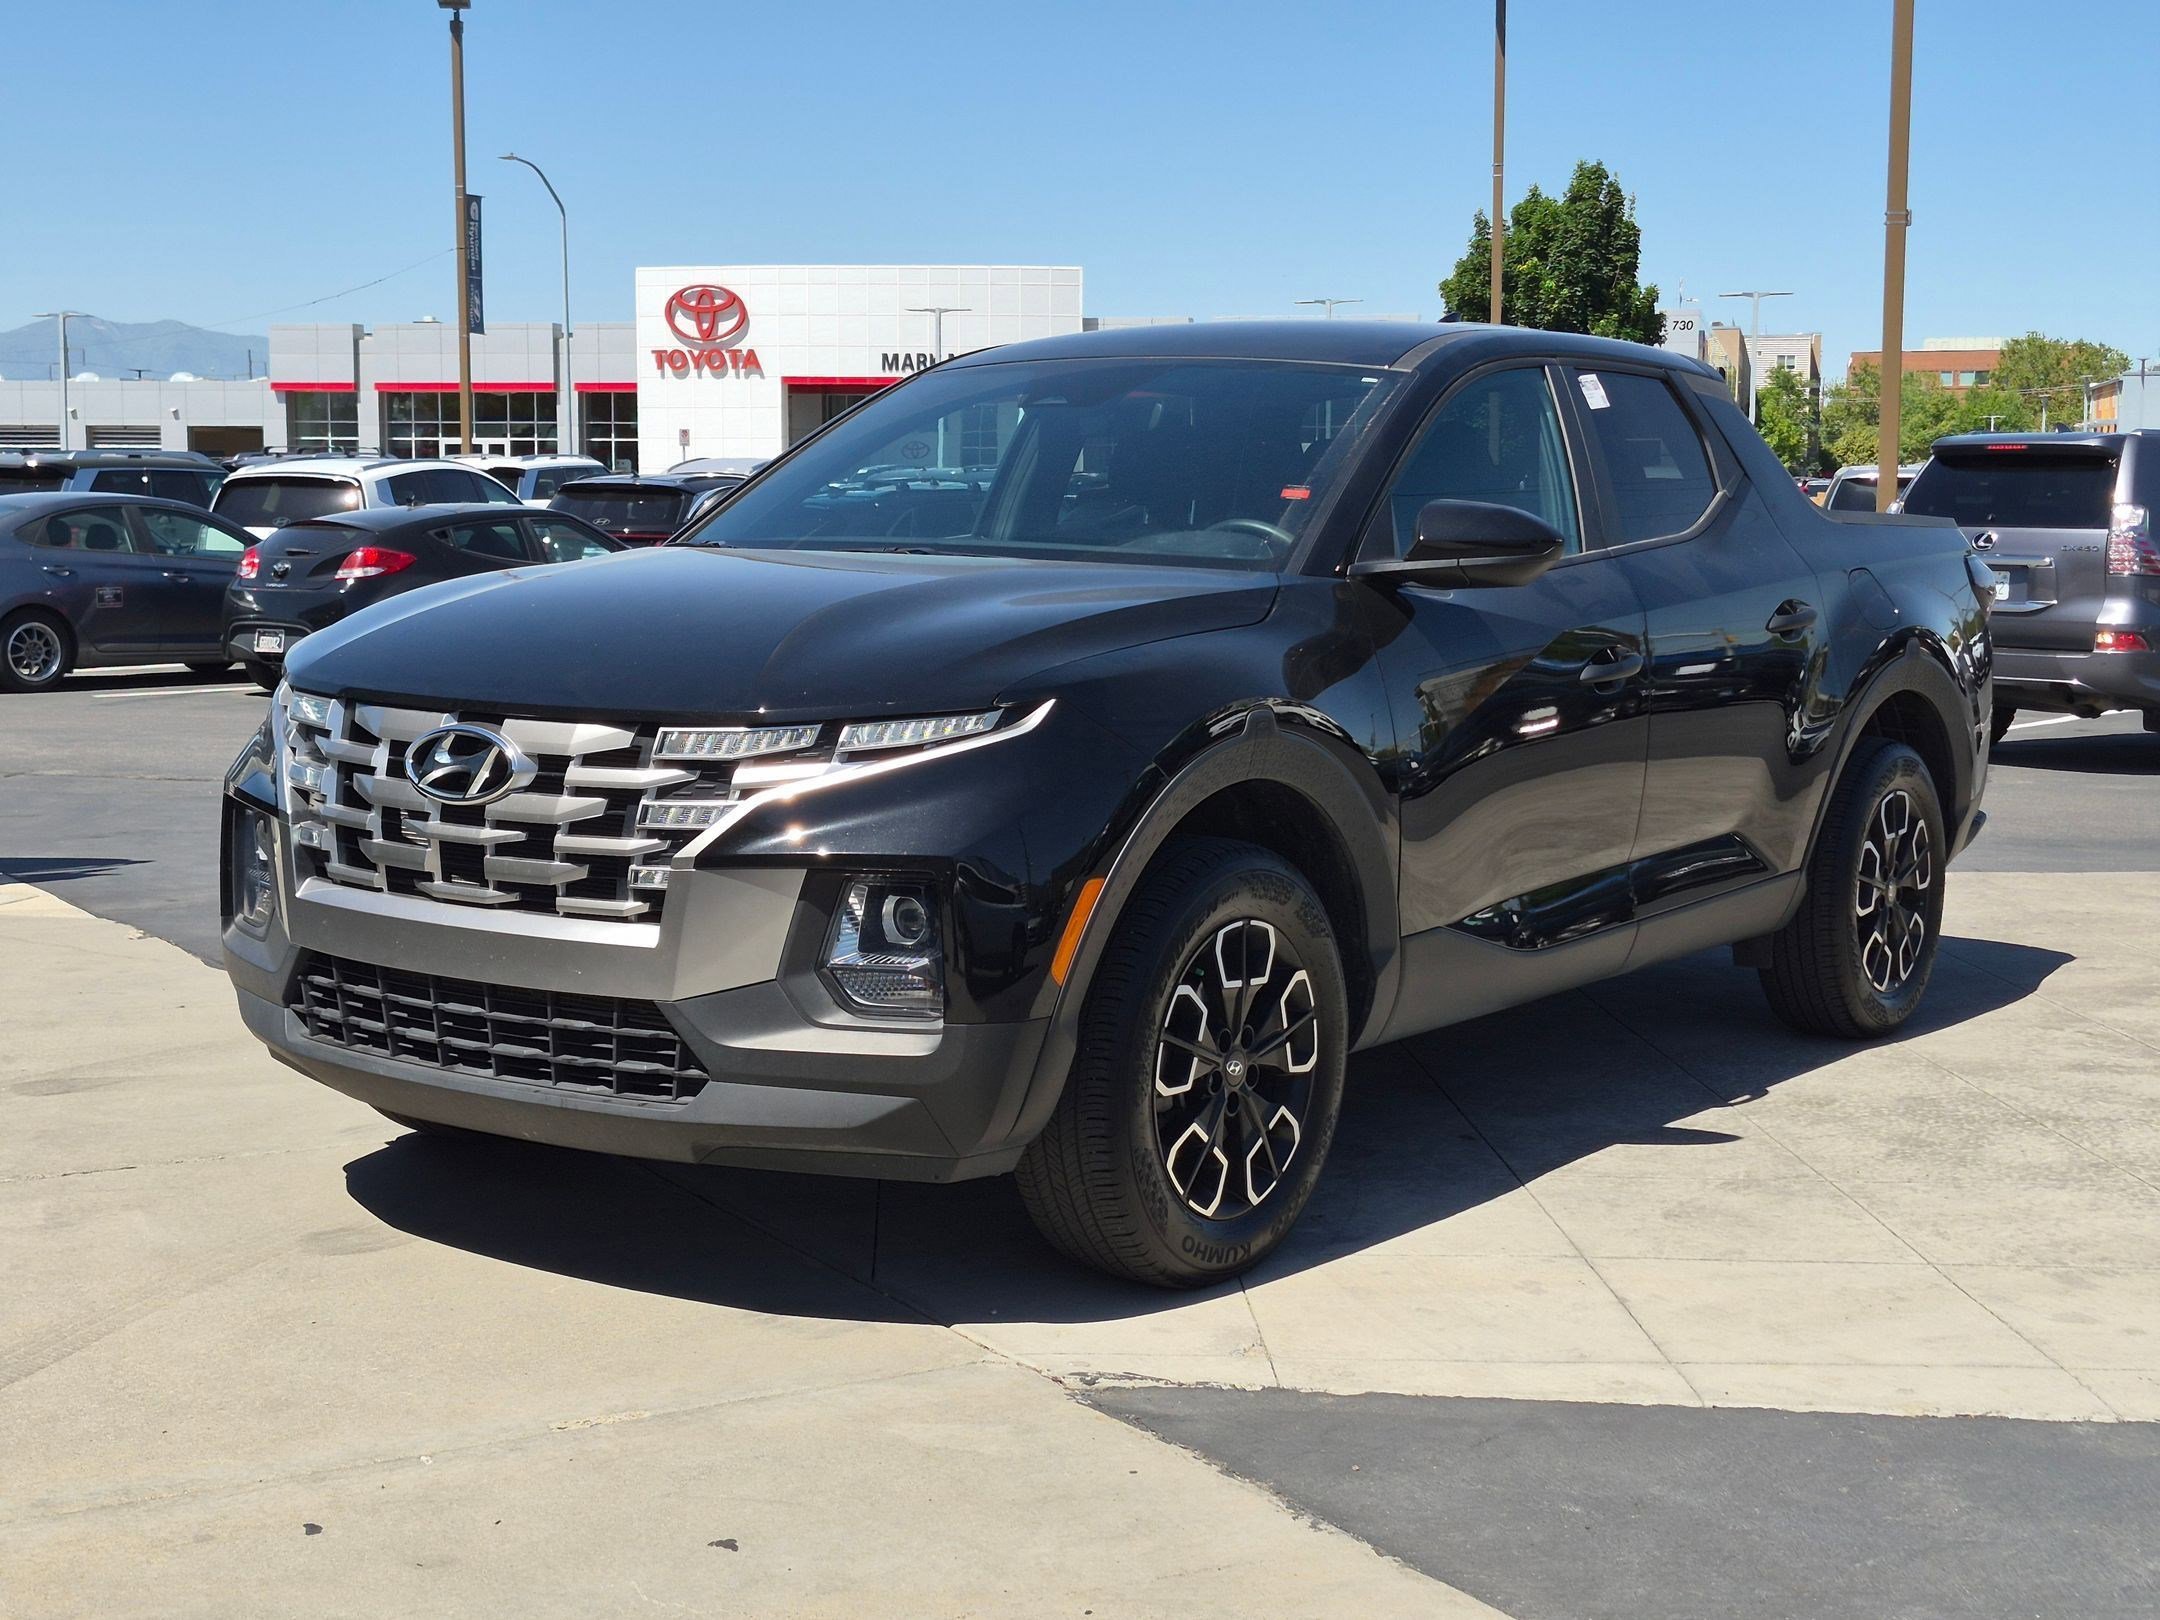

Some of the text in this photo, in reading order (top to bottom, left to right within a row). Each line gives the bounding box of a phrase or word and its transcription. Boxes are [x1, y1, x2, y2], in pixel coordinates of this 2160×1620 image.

[1672, 320, 1694, 331] 730
[651, 349, 762, 371] TOYOTA
[1182, 1235, 1251, 1264] KUMHO
